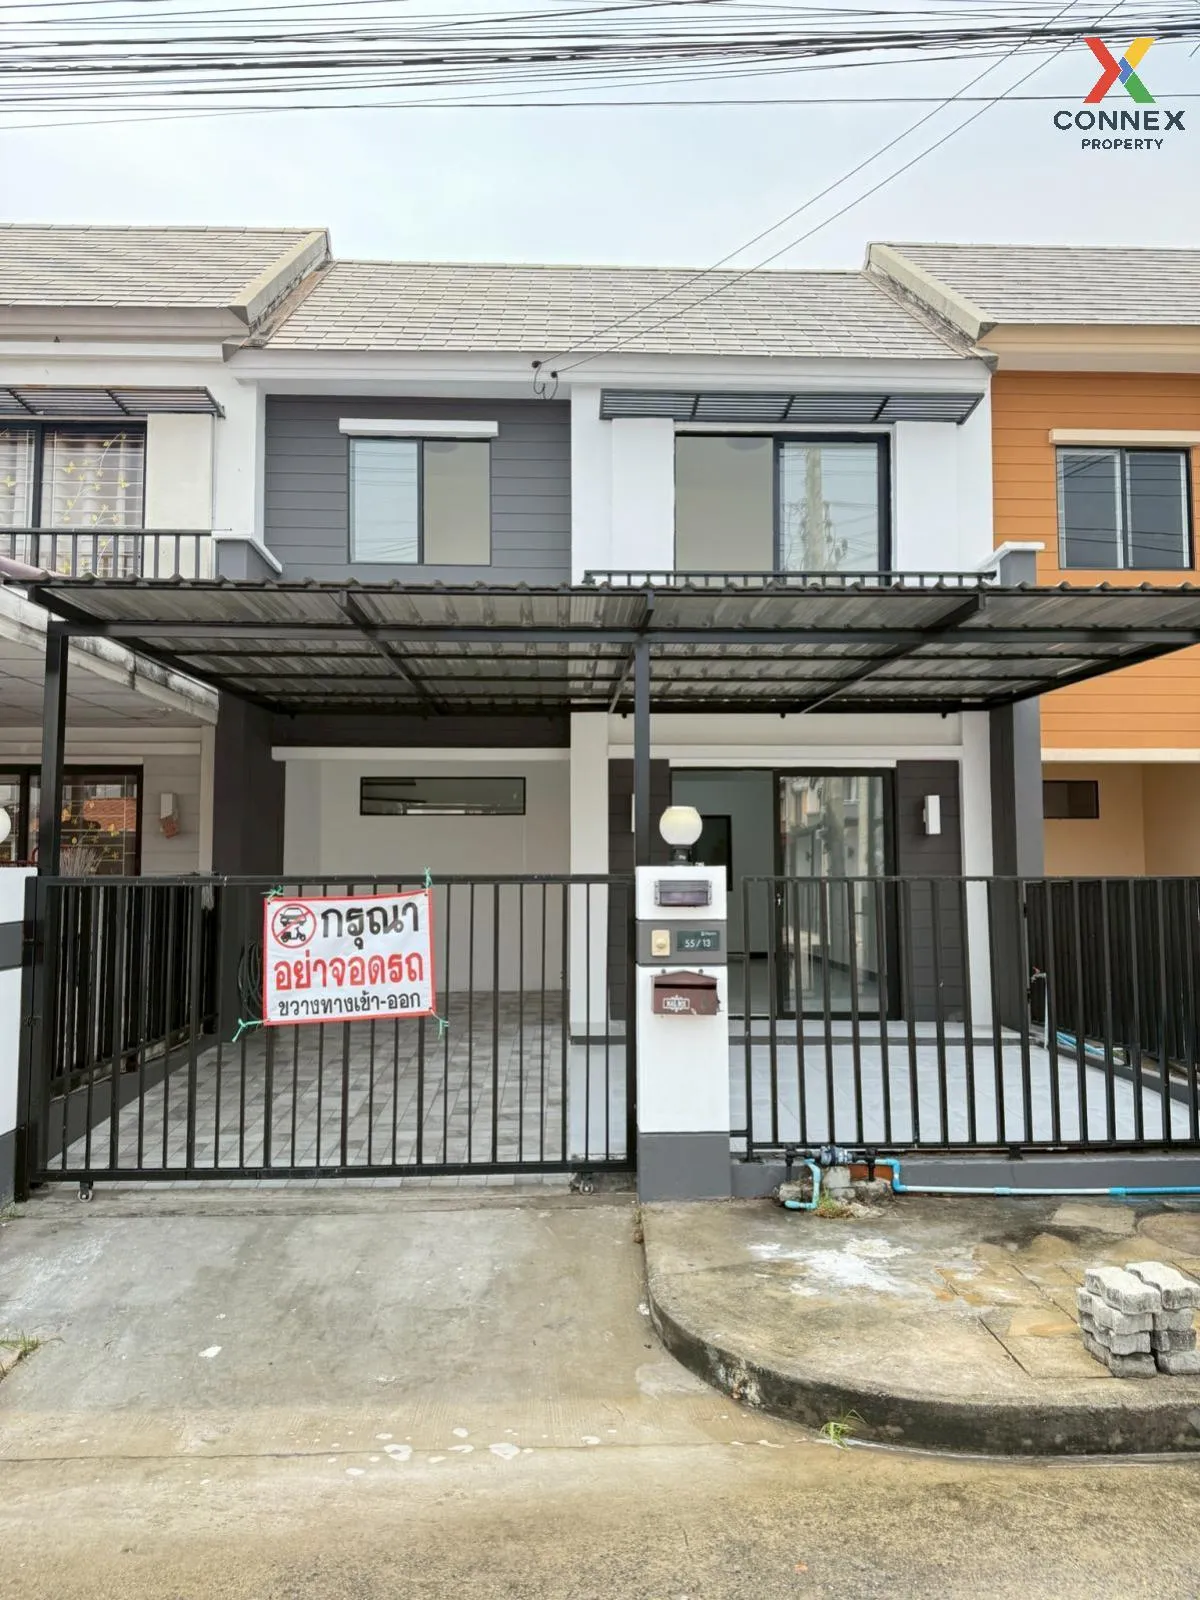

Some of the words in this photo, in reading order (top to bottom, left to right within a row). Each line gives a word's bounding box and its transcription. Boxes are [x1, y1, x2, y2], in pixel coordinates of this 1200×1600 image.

[321, 902, 419, 950] กรุณา
[274, 950, 424, 990] อย่าจอดรถ
[278, 990, 421, 1017] ขวางทางเข้า-ออก
